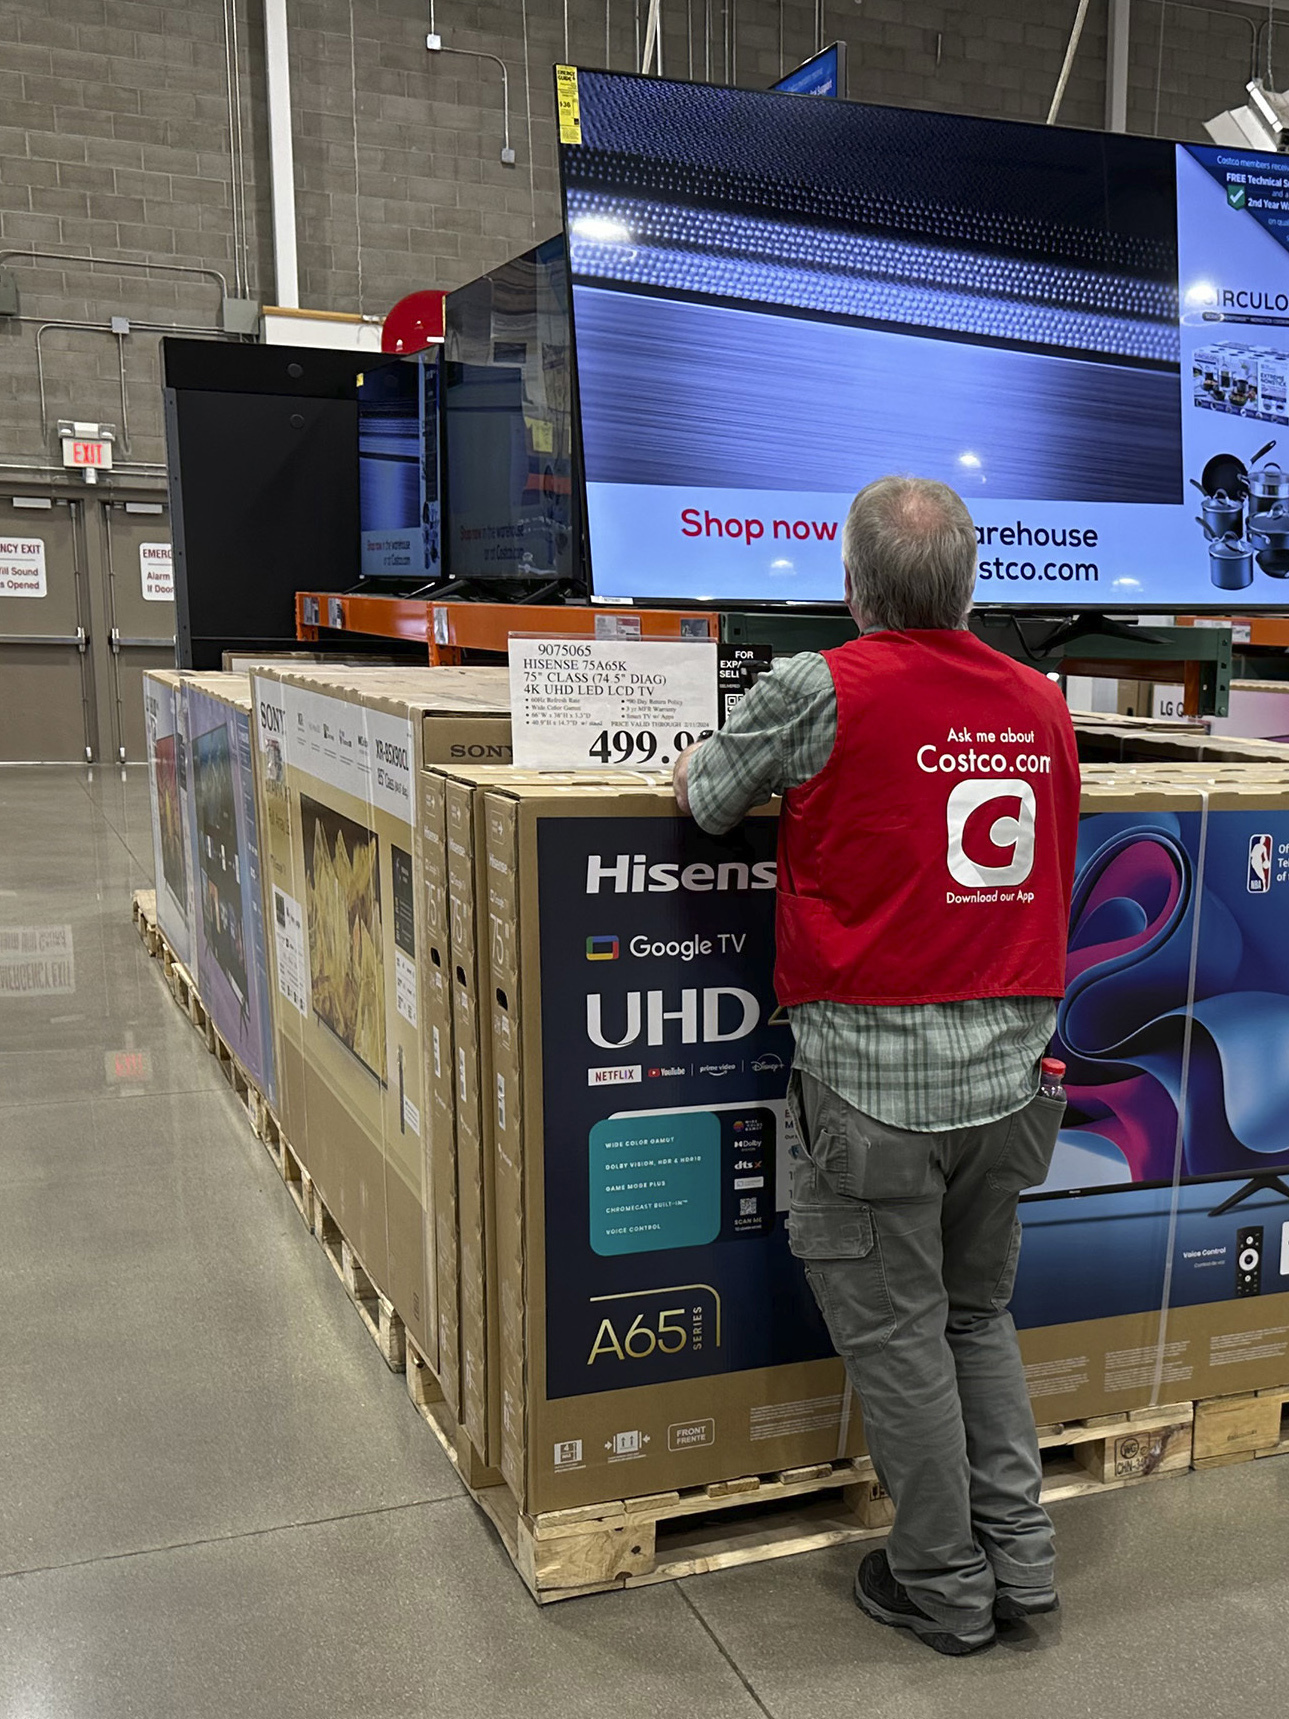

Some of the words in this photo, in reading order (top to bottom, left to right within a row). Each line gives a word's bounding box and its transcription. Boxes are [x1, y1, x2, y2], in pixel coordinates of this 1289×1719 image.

[1217, 155, 1239, 165] Costco
[1240, 159, 1270, 169] members
[1226, 172, 1246, 183] FREE
[1247, 175, 1282, 187] Technical
[1247, 198, 1263, 208] 2nd
[1263, 200, 1280, 209] Year
[73, 442, 103, 465] EXIT
[681, 508, 765, 545] Shop
[773, 521, 839, 541] now
[21, 544, 40, 554] EXIT
[11, 567, 38, 576] Sound
[147, 572, 170, 580] Alarm
[7, 581, 39, 590] Opened
[537, 644, 592, 657] 9075065
[735, 651, 754, 659] FOR
[523, 659, 579, 670] HISENSE
[583, 660, 627, 672] 75A65K
[523, 671, 543, 682] 75"
[547, 672, 588, 684] CLASS
[592, 673, 626, 685] (74.5"
[630, 674, 667, 686] DIAG)
[523, 684, 540, 695] 4K
[544, 685, 574, 696] UHD
[578, 685, 604, 696] LED
[607, 686, 635, 696] LCD
[637, 686, 655, 697] TV
[1160, 700, 1173, 716] LG
[261, 701, 286, 736] SONY
[946, 727, 973, 744] Ask
[976, 732, 996, 743] me
[999, 727, 1035, 743] about
[1276, 871, 1287, 882] of
[1250, 879, 1262, 890] NBA
[946, 891, 998, 904] Download
[1000, 892, 1015, 901] our
[1016, 890, 1035, 903] App
[629, 934, 712, 962] Google
[717, 933, 747, 953] TV
[586, 986, 761, 1049] UHD
[660, 1067, 686, 1077] YouTube
[699, 1065, 718, 1073] prime
[718, 1063, 736, 1071] video
[595, 1068, 634, 1083] NETFLIX
[625, 1139, 648, 1147] COLOR
[650, 1136, 675, 1144] GAMUT
[743, 1140, 762, 1148] Dolby
[605, 1162, 628, 1171] DOLBY
[629, 1160, 656, 1168] VISION,
[734, 1161, 753, 1170] dts
[605, 1184, 625, 1192] GAME
[627, 1182, 647, 1190] MODE
[606, 1203, 652, 1214] CHROMECAST
[606, 1227, 627, 1235] VOICE
[629, 1223, 661, 1233] CONTROL
[1183, 1250, 1202, 1259] Voice
[1202, 1247, 1227, 1256] Control
[693, 1305, 703, 1350] SERIES
[586, 1308, 687, 1366] A65
[676, 1425, 706, 1438] FRONT
[676, 1434, 706, 1445] FRENTE
